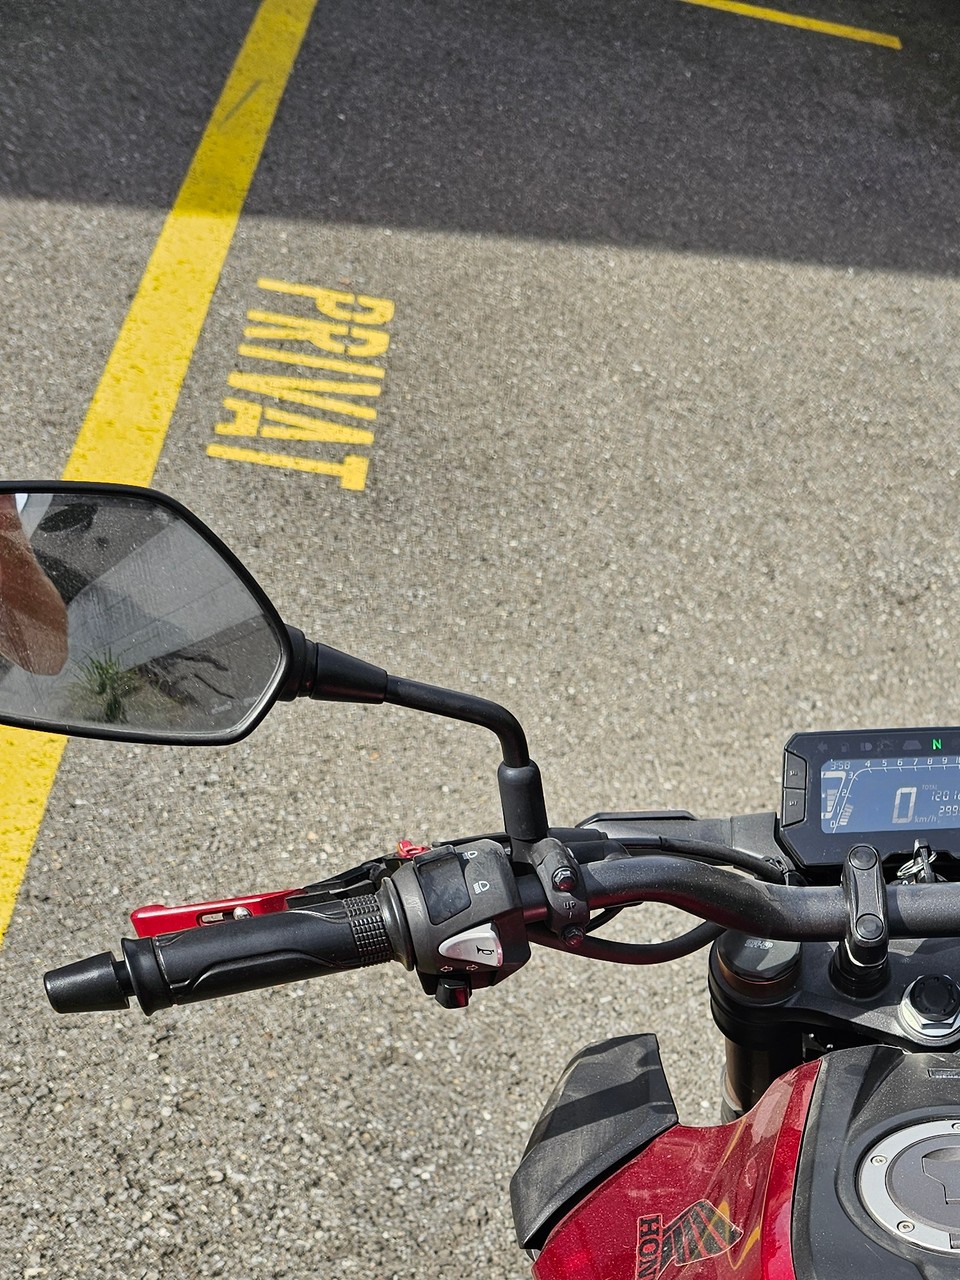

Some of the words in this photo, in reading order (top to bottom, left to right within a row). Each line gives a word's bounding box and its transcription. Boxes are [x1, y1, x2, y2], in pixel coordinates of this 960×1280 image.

[206, 277, 395, 491] PRIVAT
[932, 739, 942, 750] N
[892, 787, 916, 824] 0
[914, 815, 937, 823] km/h
[564, 900, 576, 908] UP
